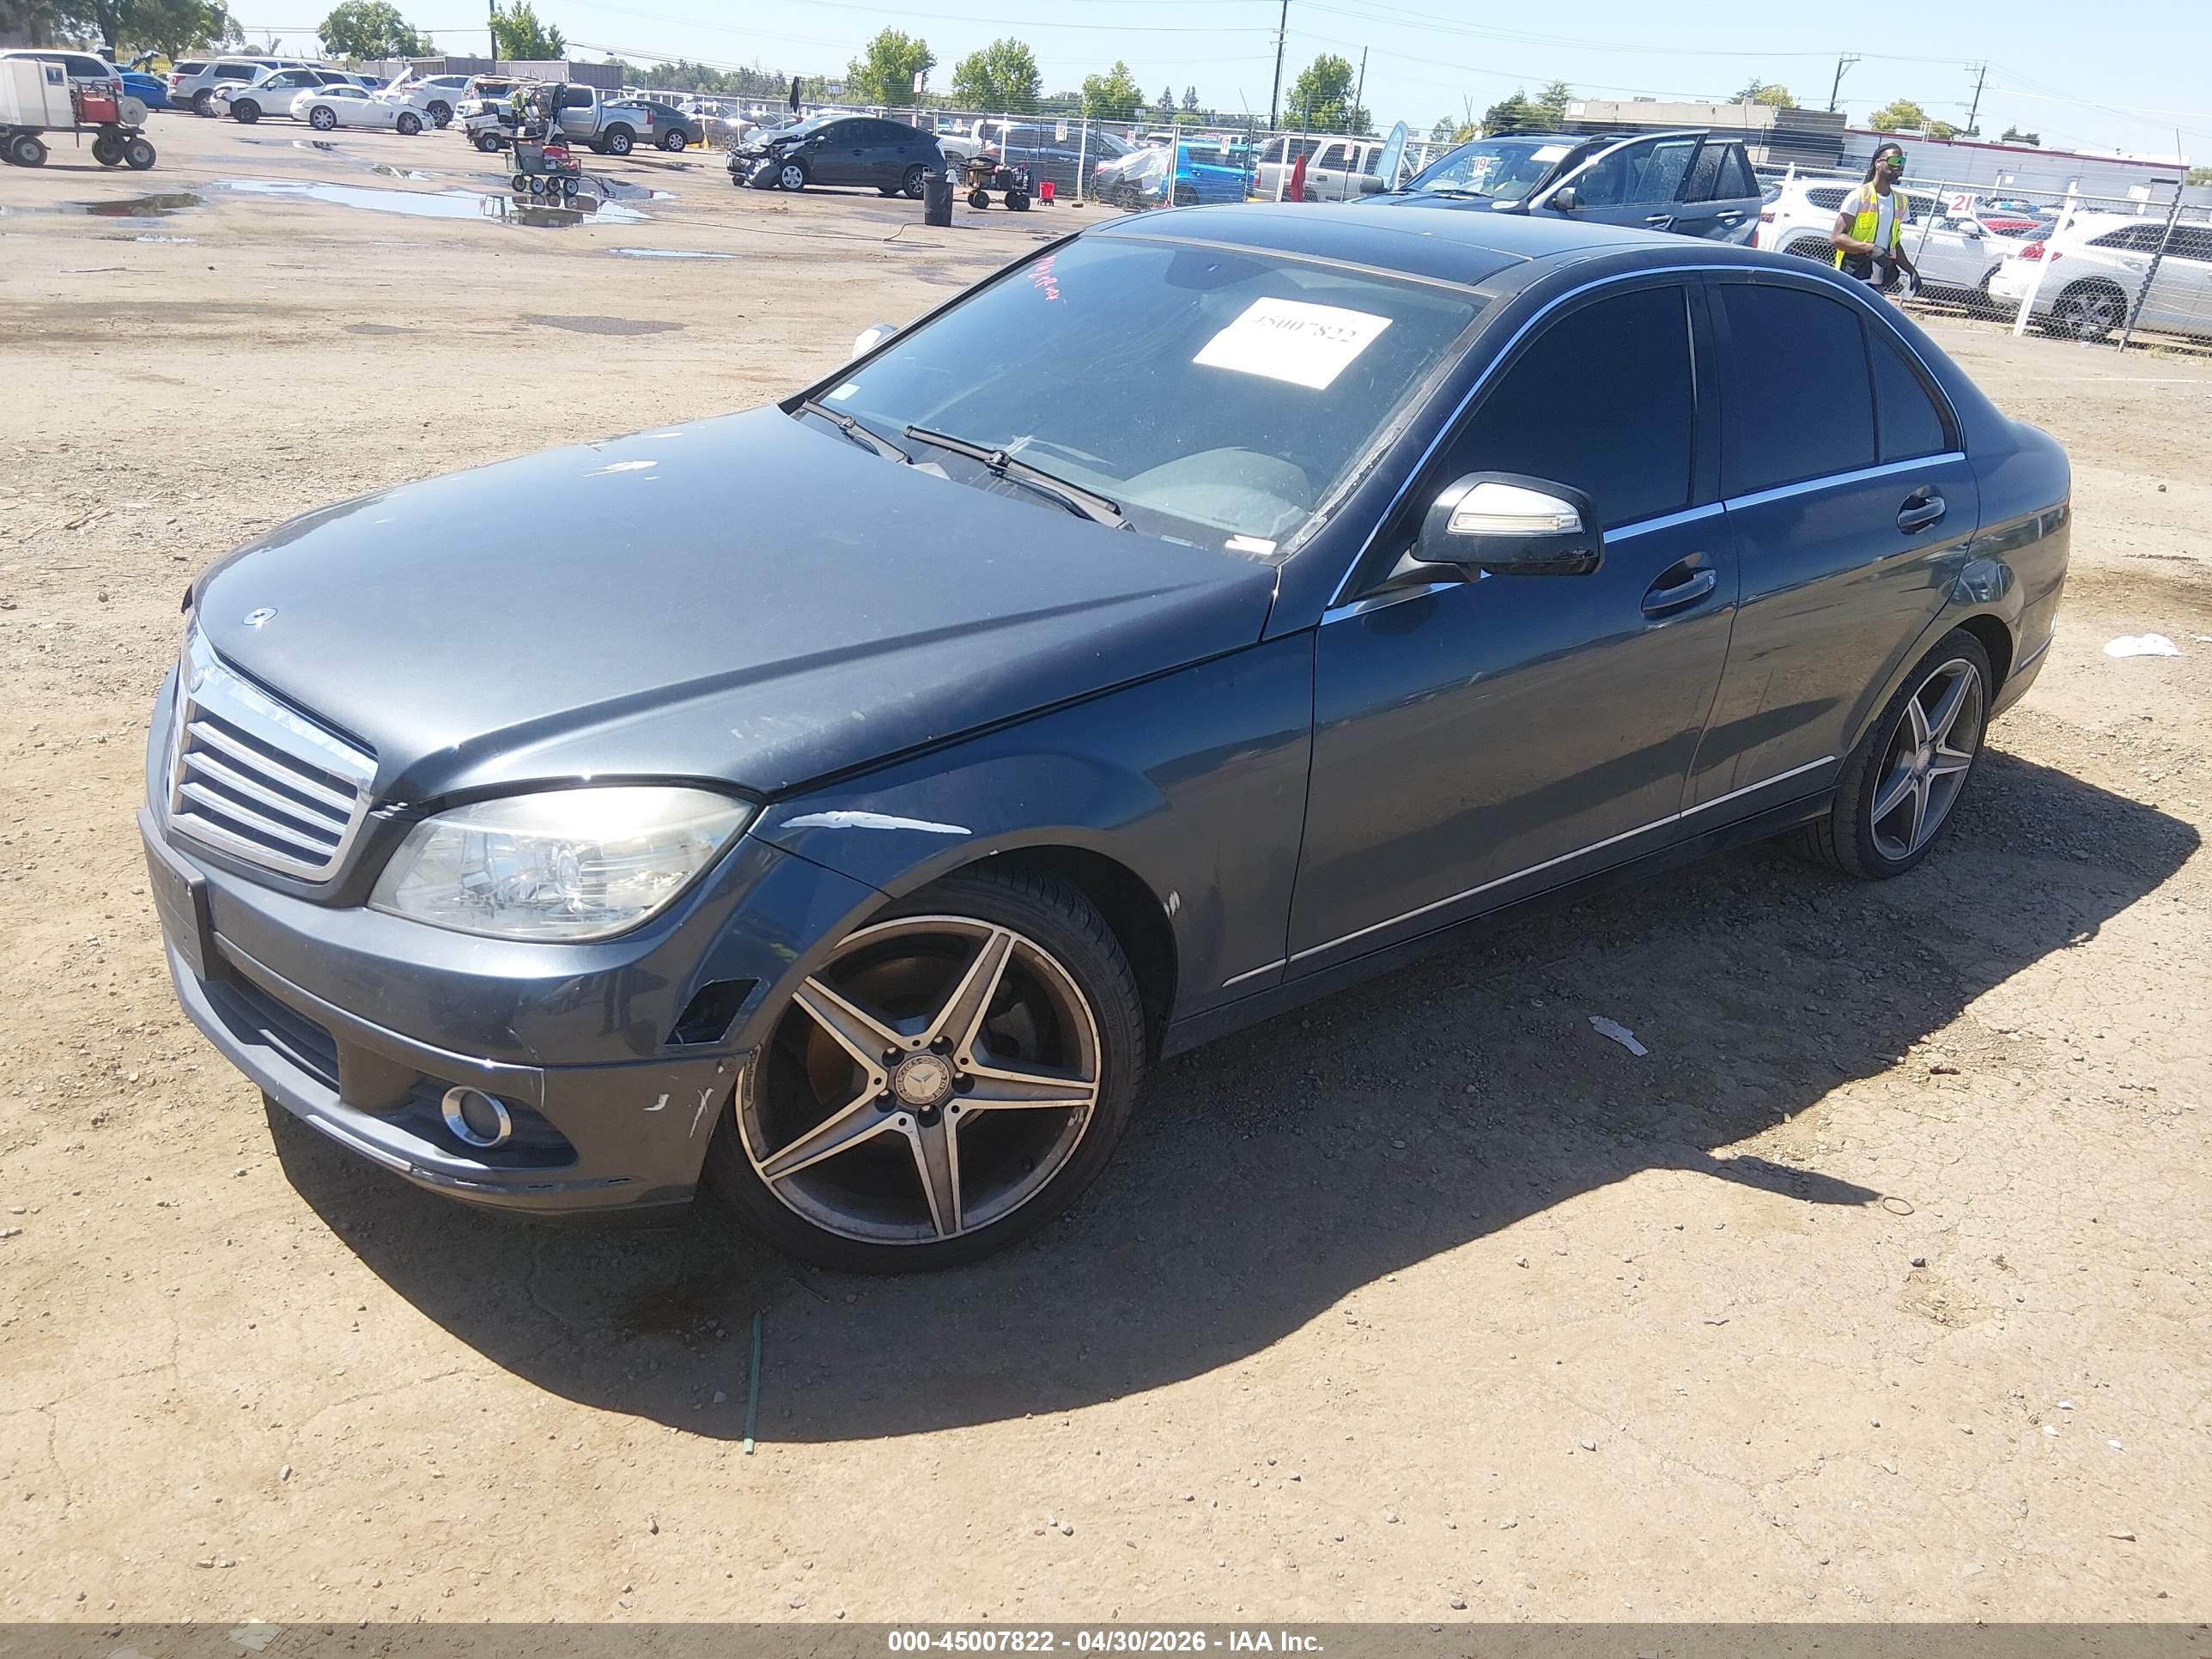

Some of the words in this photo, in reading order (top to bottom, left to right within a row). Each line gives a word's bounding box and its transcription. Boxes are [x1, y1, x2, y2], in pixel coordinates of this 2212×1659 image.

[1127, 131, 1135, 143] 16
[1474, 157, 1487, 171] 19
[1951, 194, 1973, 210] 21
